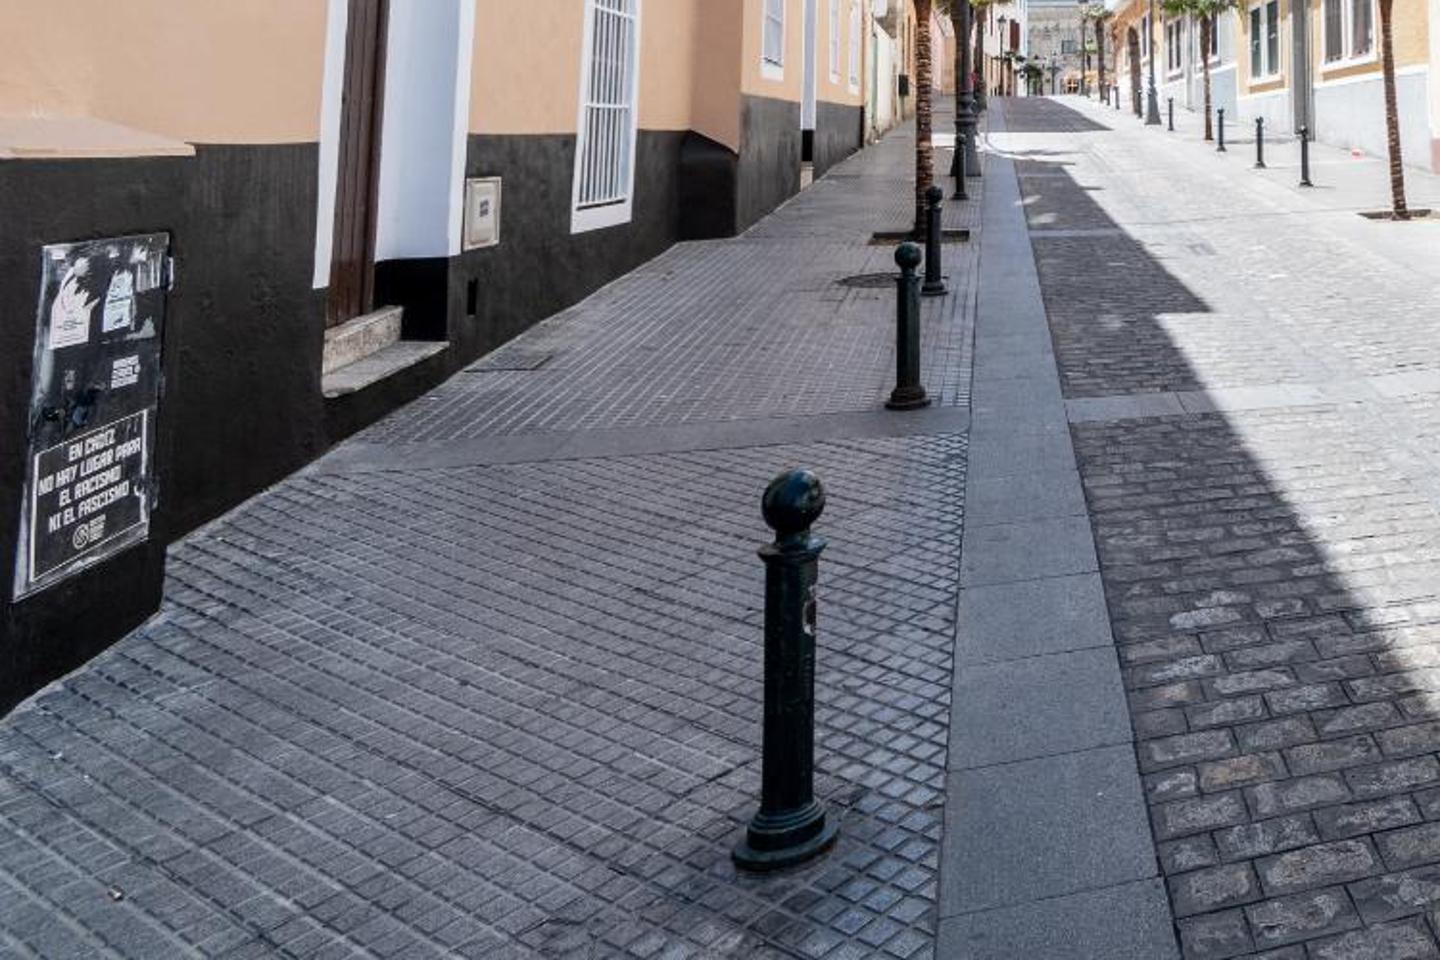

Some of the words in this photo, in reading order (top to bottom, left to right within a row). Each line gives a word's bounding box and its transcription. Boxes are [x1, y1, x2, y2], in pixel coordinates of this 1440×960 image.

[38, 474, 55, 496] NO
[55, 464, 78, 488] HAY
[80, 447, 114, 477] LUGAR
[114, 436, 142, 461] PARA
[68, 440, 84, 462] EN
[48, 511, 63, 534] NI
[62, 506, 76, 526] EL
[78, 479, 130, 519] FASCISMO
[58, 487, 72, 508] EL
[74, 463, 122, 500] RACISMO
